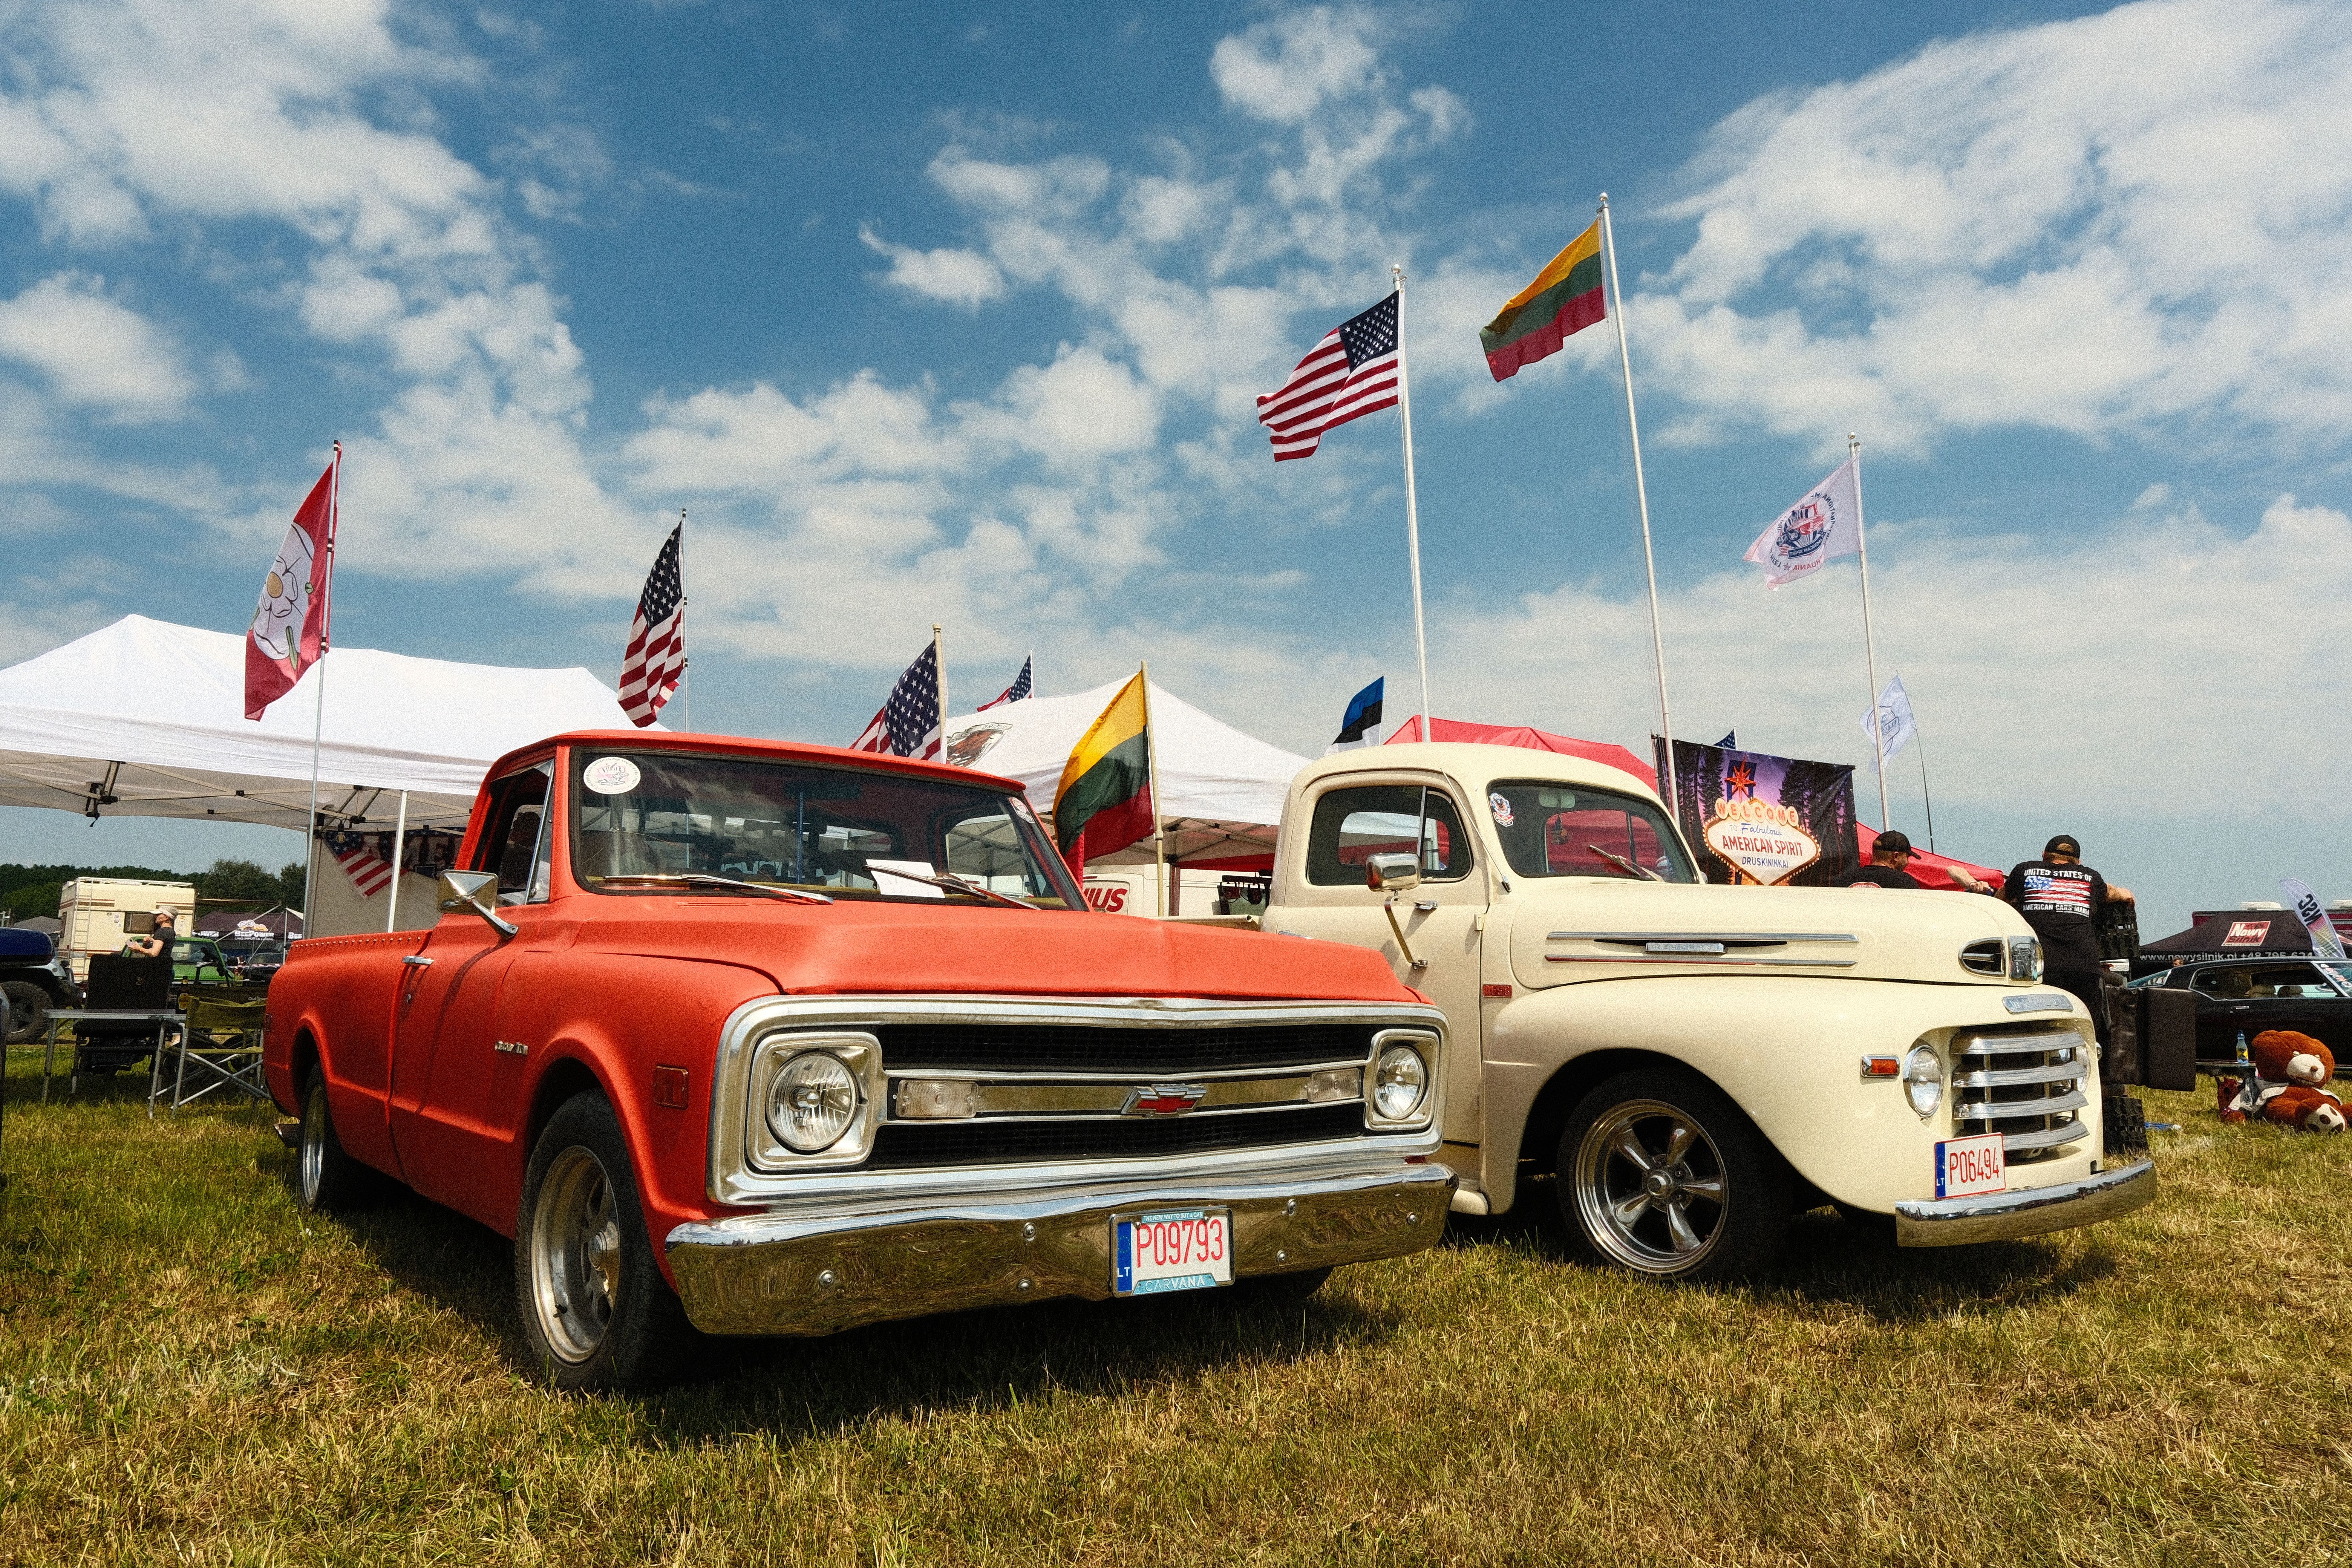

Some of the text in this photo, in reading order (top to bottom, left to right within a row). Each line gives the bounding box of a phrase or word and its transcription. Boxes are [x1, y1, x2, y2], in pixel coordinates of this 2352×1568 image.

[1717, 802, 1796, 822] WELCOME
[1741, 823, 1782, 836] Fabulous
[1723, 835, 1803, 856] AMERICAN SPIRIT
[1742, 856, 1789, 868] DRUSKININKAI
[2053, 870, 2083, 879] STATES
[1084, 888, 1128, 913] IUS
[2230, 923, 2266, 938] Nowy
[2139, 952, 2237, 961] www.nowysilnik.pl
[1936, 1147, 1999, 1186] LT P06494
[1117, 1219, 1223, 1278] LT P09793
[1145, 1274, 1205, 1292] CARVANA
